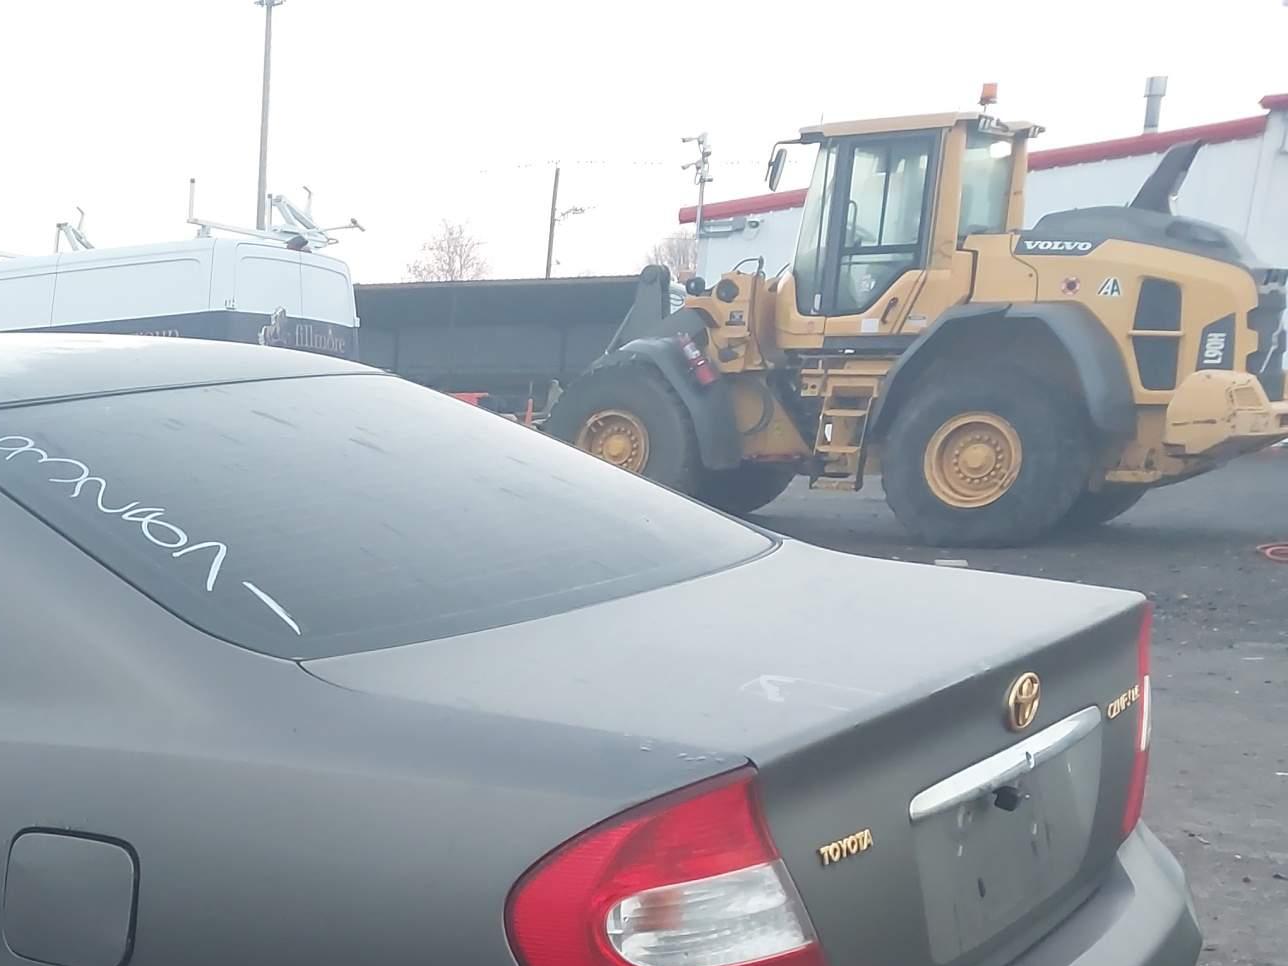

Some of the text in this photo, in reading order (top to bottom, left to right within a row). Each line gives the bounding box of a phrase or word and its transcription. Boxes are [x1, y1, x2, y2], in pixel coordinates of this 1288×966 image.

[1023, 240, 1092, 251] VOLVO
[295, 323, 346, 354] fillmore
[1203, 332, 1227, 364] L90H
[819, 828, 874, 866] TOYOTA
